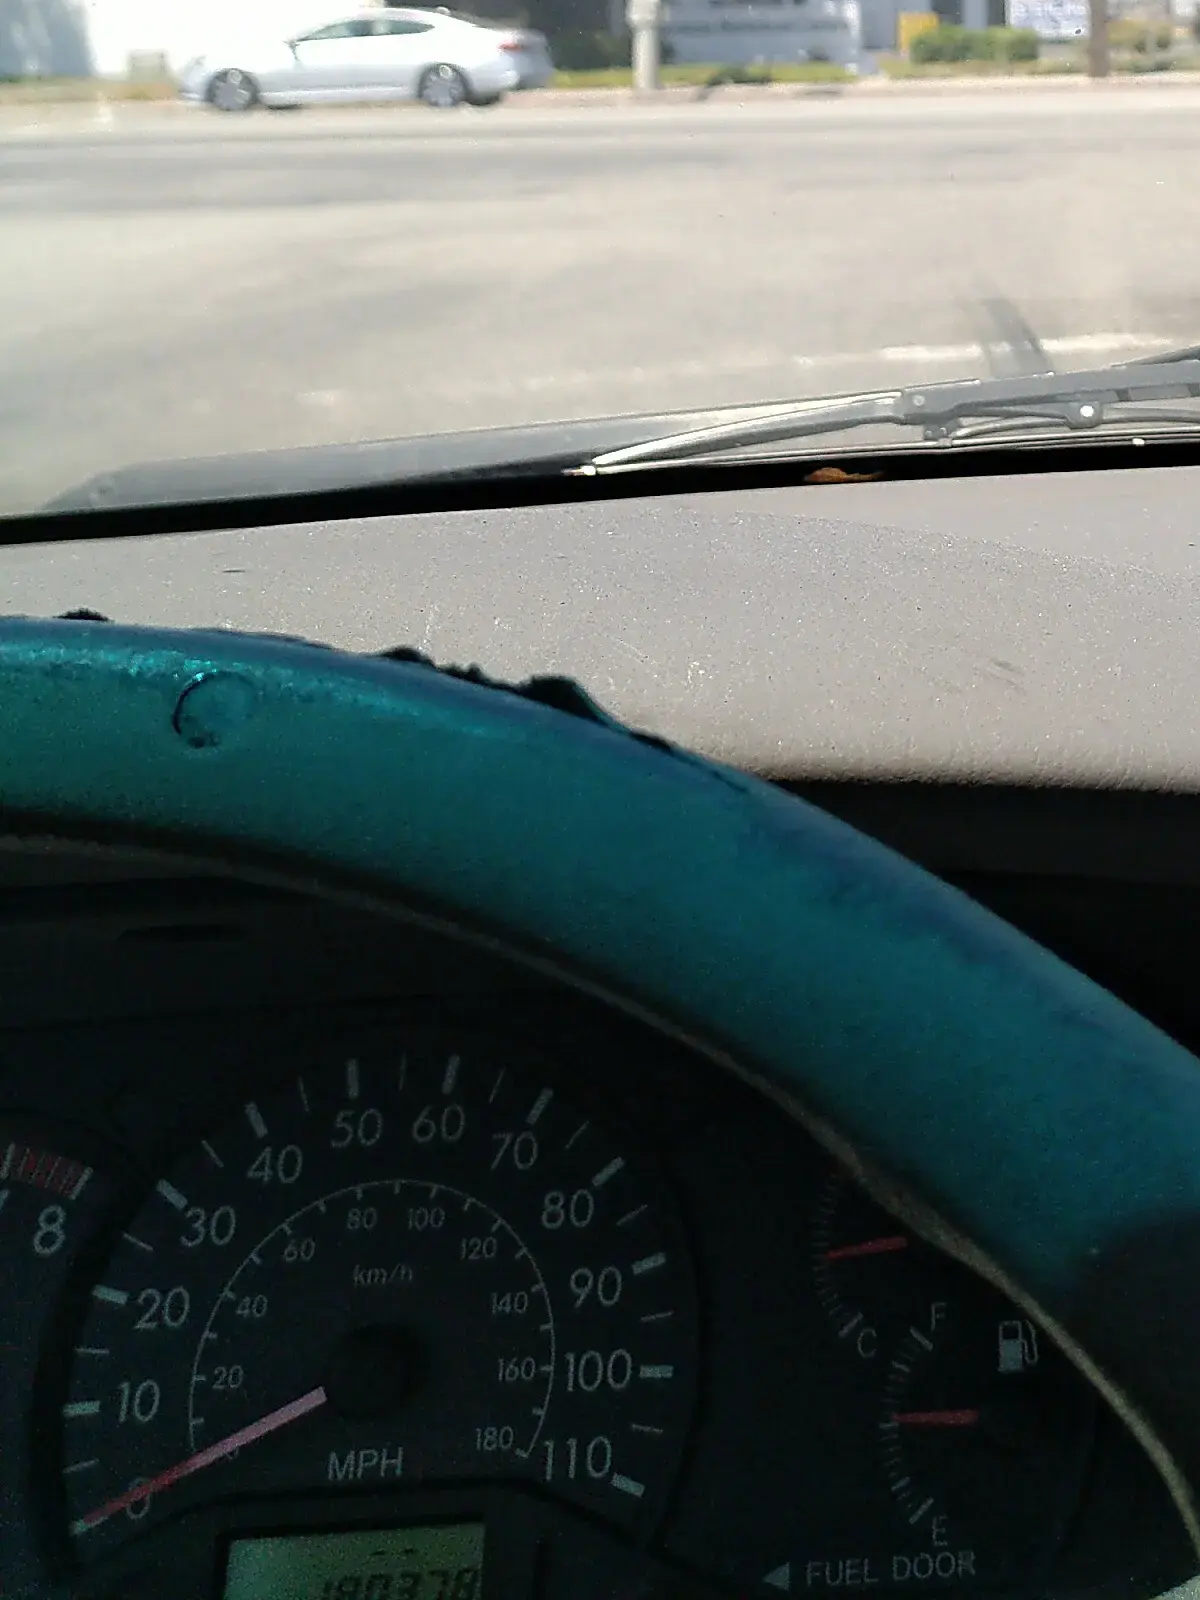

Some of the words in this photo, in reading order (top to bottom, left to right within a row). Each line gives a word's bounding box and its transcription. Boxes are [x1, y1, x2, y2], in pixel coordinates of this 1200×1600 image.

[331, 1108, 383, 1148] 50
[412, 1103, 466, 1143] 60
[247, 1144, 303, 1184] 40
[490, 1131, 539, 1170] 70
[180, 1205, 237, 1247] 30
[346, 1207, 378, 1230] 80
[407, 1206, 445, 1230] 100
[541, 1189, 594, 1229] 80
[33, 1205, 66, 1254] 8
[282, 1238, 316, 1262] 60
[461, 1237, 498, 1260] 120
[353, 1263, 413, 1286] km/h
[569, 1266, 622, 1309] 90
[133, 1286, 190, 1329] 20
[235, 1294, 268, 1318] 40
[491, 1291, 529, 1315] 140
[930, 1301, 947, 1331] F
[856, 1327, 878, 1358] C
[212, 1365, 244, 1390] 20
[497, 1356, 536, 1382] 160
[565, 1348, 633, 1392] 100
[117, 1379, 160, 1423] 10
[475, 1425, 515, 1451] 180
[327, 1447, 404, 1481] MPH
[544, 1436, 613, 1482] 110
[932, 1514, 948, 1547] E
[806, 1558, 879, 1587] FUEL
[892, 1550, 977, 1581] DOOR
